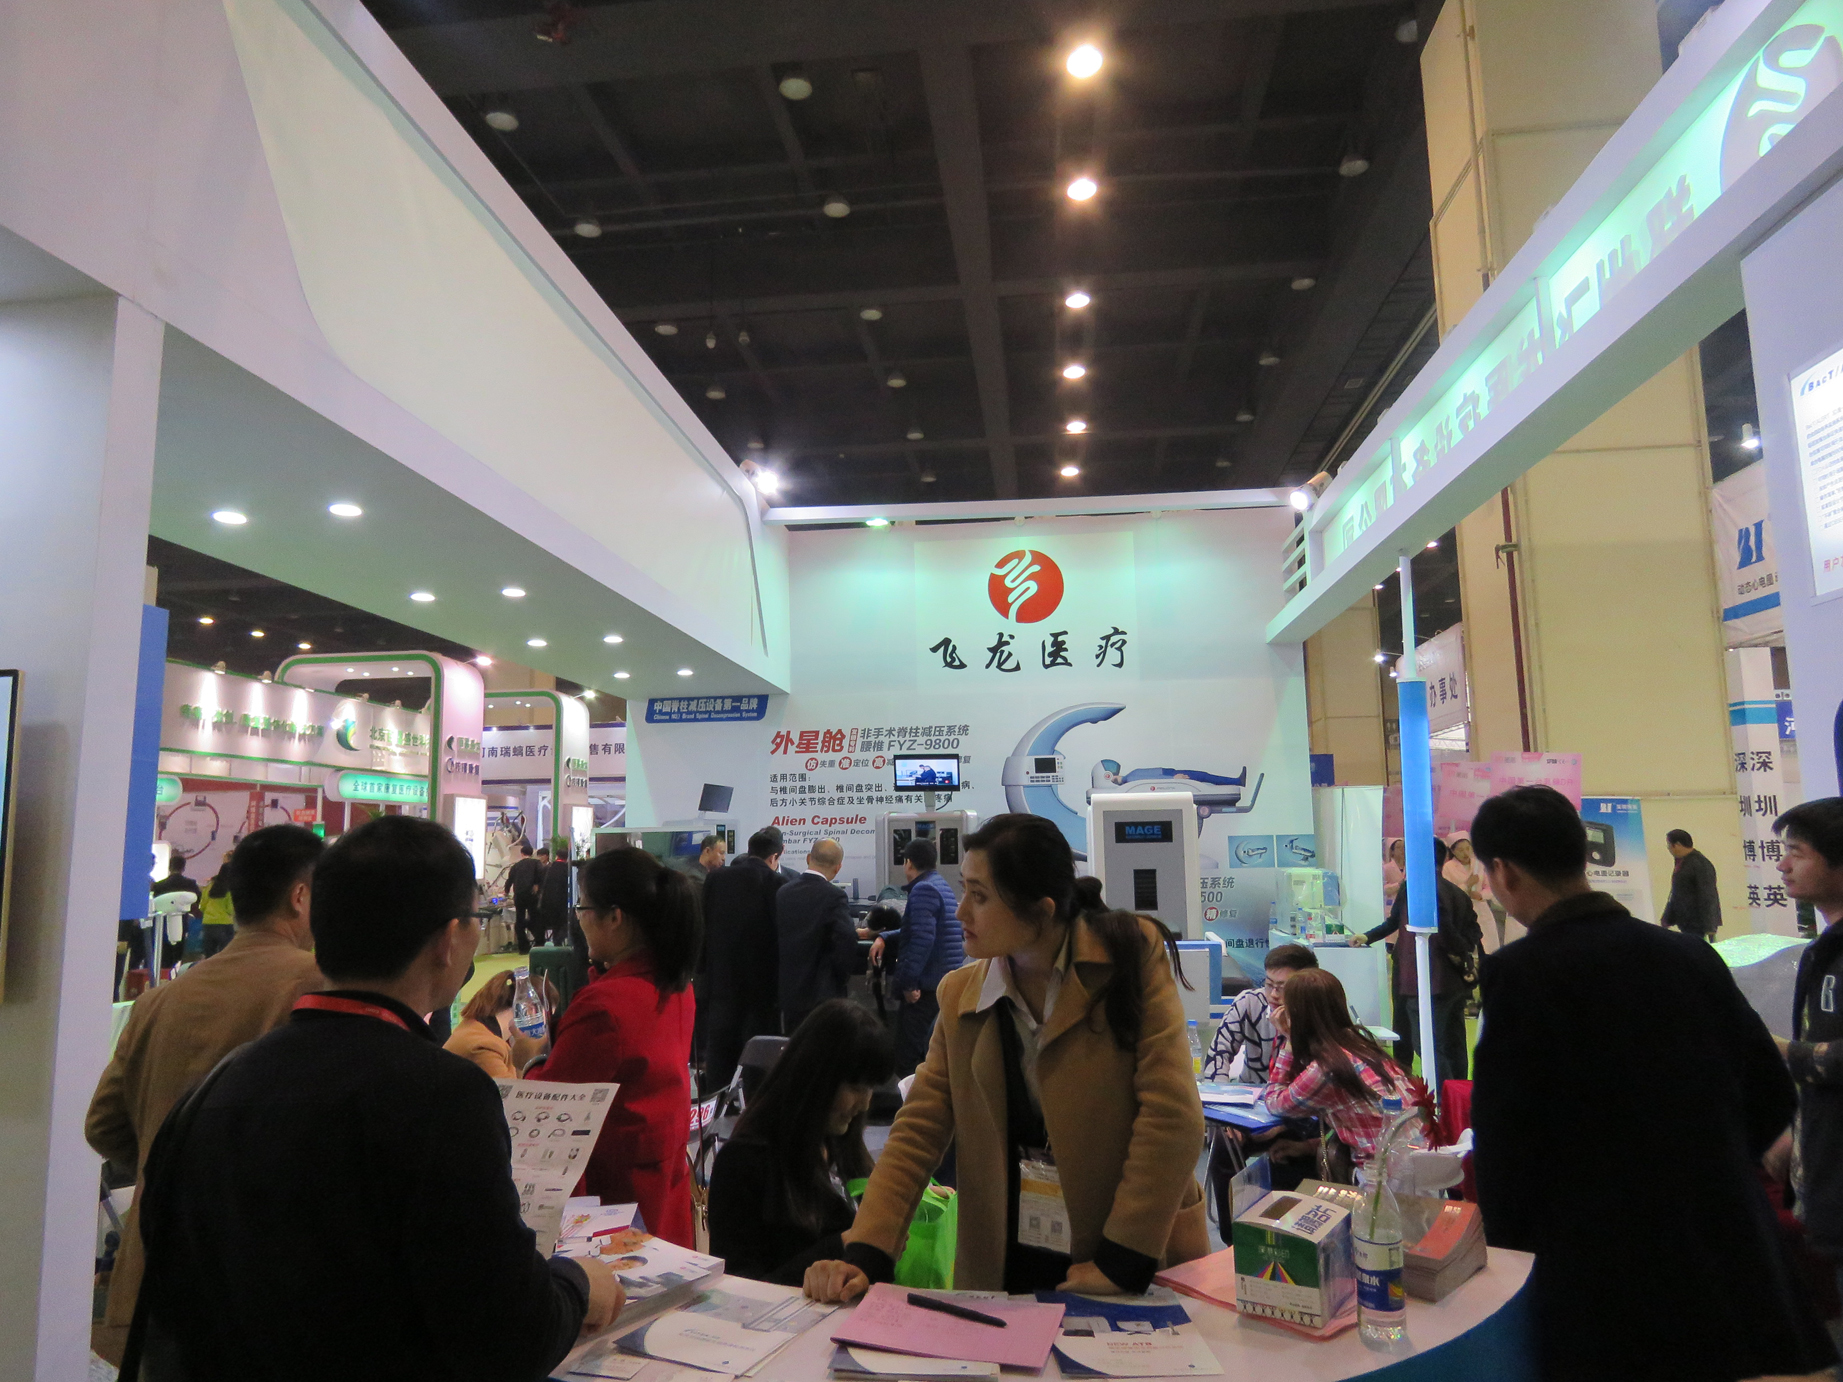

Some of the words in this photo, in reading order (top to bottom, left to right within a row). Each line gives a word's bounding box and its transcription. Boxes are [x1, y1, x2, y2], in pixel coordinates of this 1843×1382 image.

[929, 626, 1128, 673] 飞龙医疗
[654, 697, 758, 713] 中国脊柱减压设备第一品牌
[860, 724, 970, 740] 非手术脊柱减压系统
[770, 729, 846, 755] 外星舱
[860, 741, 884, 753] 腰椎
[887, 738, 960, 751] FYZ-9800
[353, 780, 429, 797] 全球首家康复医疗设备
[1450, 789, 1490, 798] 中国第一
[772, 815, 806, 826] Alien
[811, 814, 867, 827] Capsule
[782, 828, 822, 837] n-Surgical
[824, 828, 848, 837] Spinal
[1125, 825, 1162, 835] MAGE
[1735, 752, 1760, 907] 深圳博英
[1750, 751, 1788, 907] 深圳博英
[782, 836, 801, 844] mbar
[515, 1090, 586, 1101] 医疗设备配件大全
